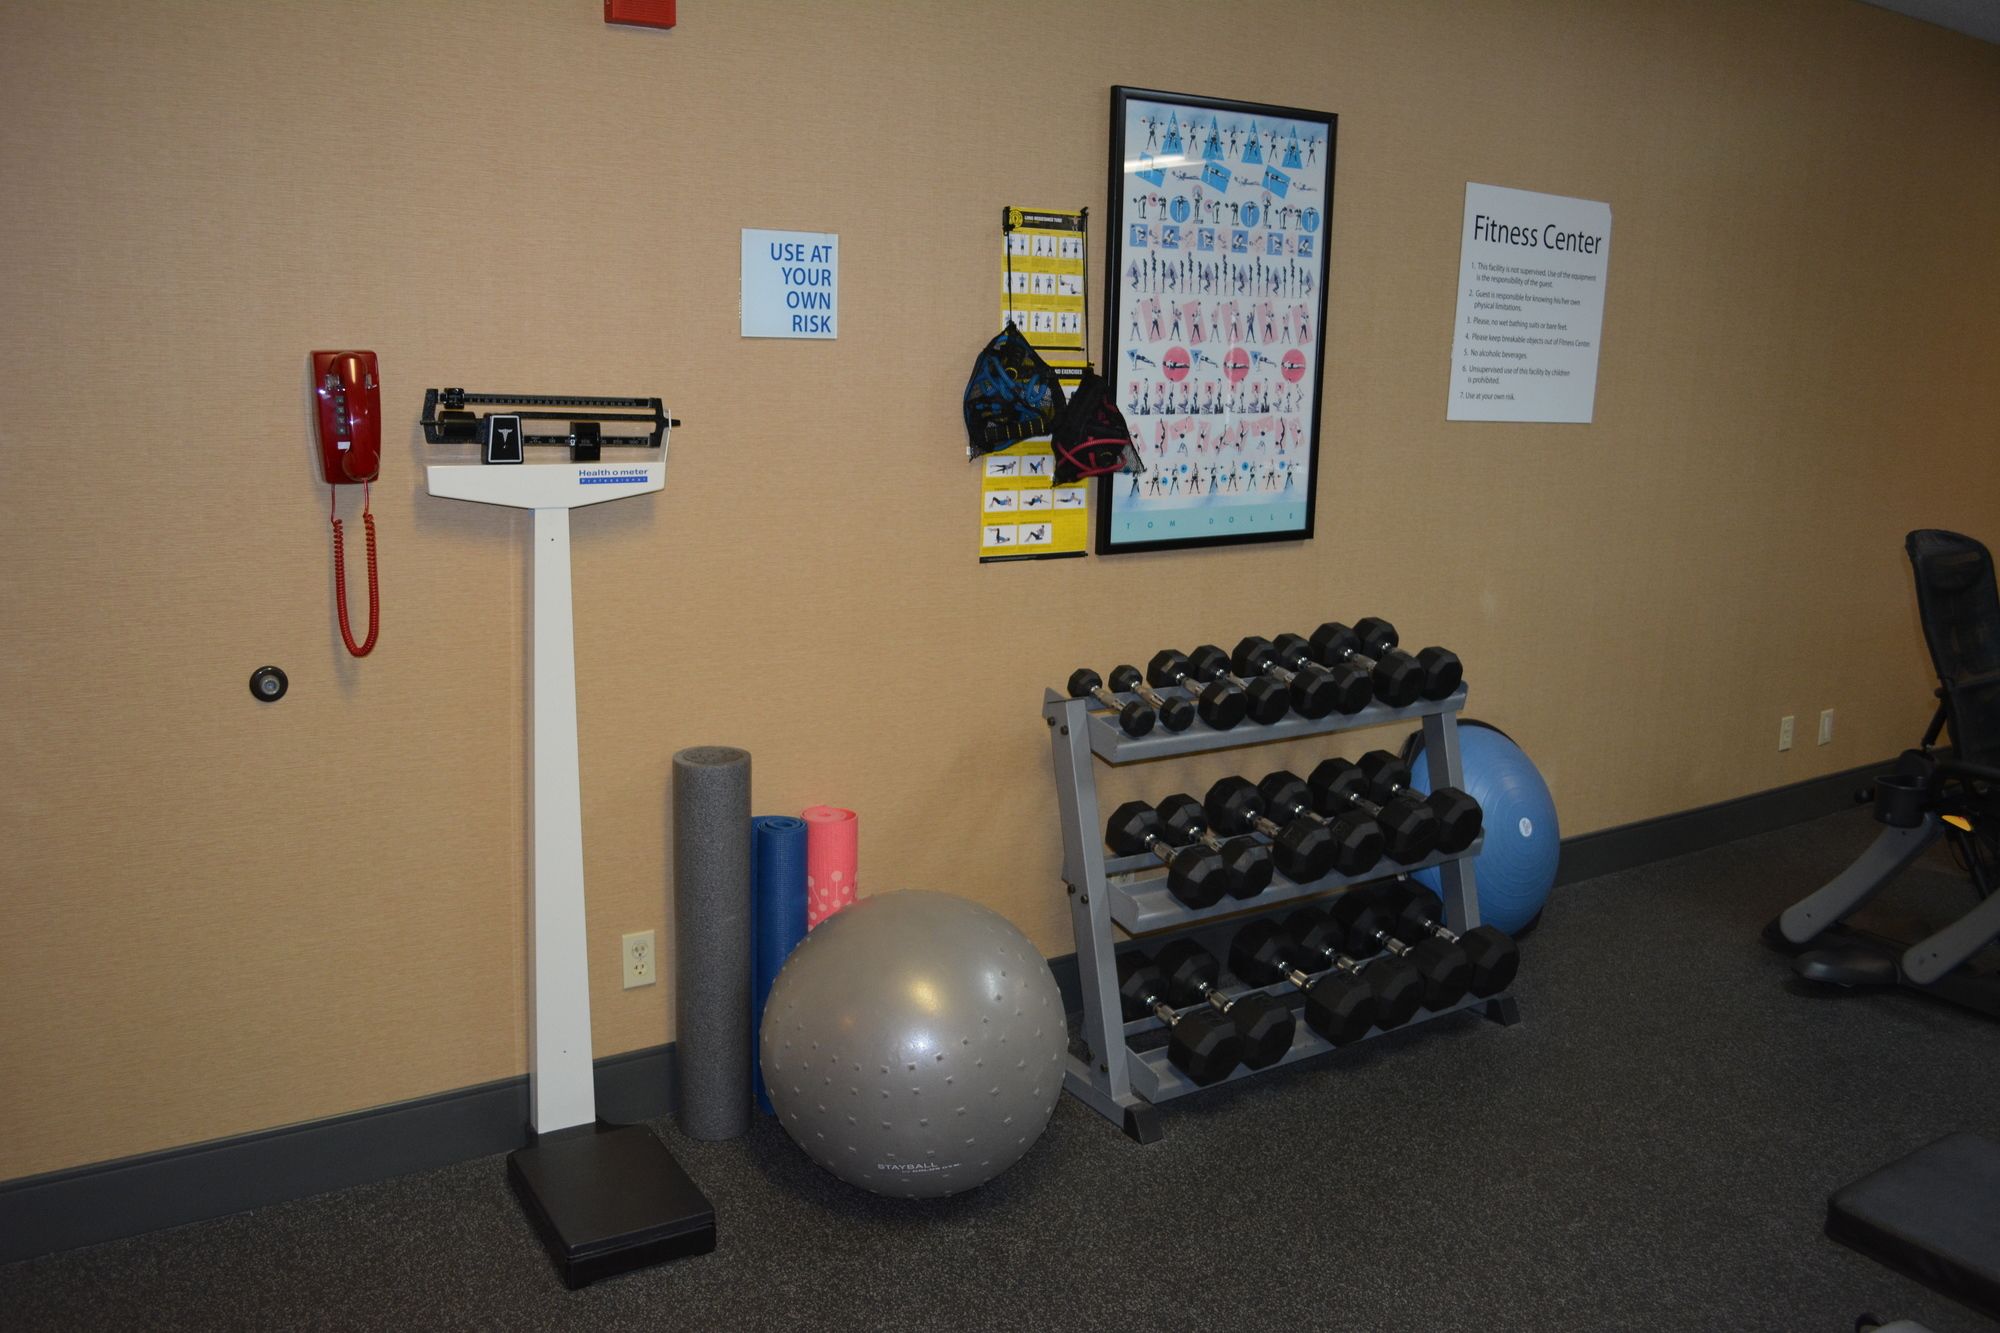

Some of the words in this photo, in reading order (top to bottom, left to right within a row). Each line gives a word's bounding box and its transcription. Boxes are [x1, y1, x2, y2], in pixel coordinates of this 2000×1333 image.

[1474, 214, 1538, 247] Fitness
[1543, 224, 1601, 254] Center
[771, 242, 804, 261] USE
[810, 245, 832, 263] AT
[782, 267, 831, 286] YOUR
[1488, 264, 1505, 273] facility
[1548, 270, 1556, 278] Use
[1491, 276, 1523, 286] responsibility
[786, 291, 830, 309] OWN
[1474, 301, 1494, 310] physical
[1496, 292, 1524, 302] responsible
[1533, 295, 1552, 305] knowing
[792, 314, 831, 333] RISK
[1509, 320, 1528, 329] bathing
[1489, 335, 1501, 343] keep
[1502, 335, 1525, 343] breakable
[1469, 366, 1503, 375] Unsupervised
[1529, 368, 1544, 376] facility
[1126, 520, 1176, 529] TOM
[1209, 513, 1293, 524] DOLLE
